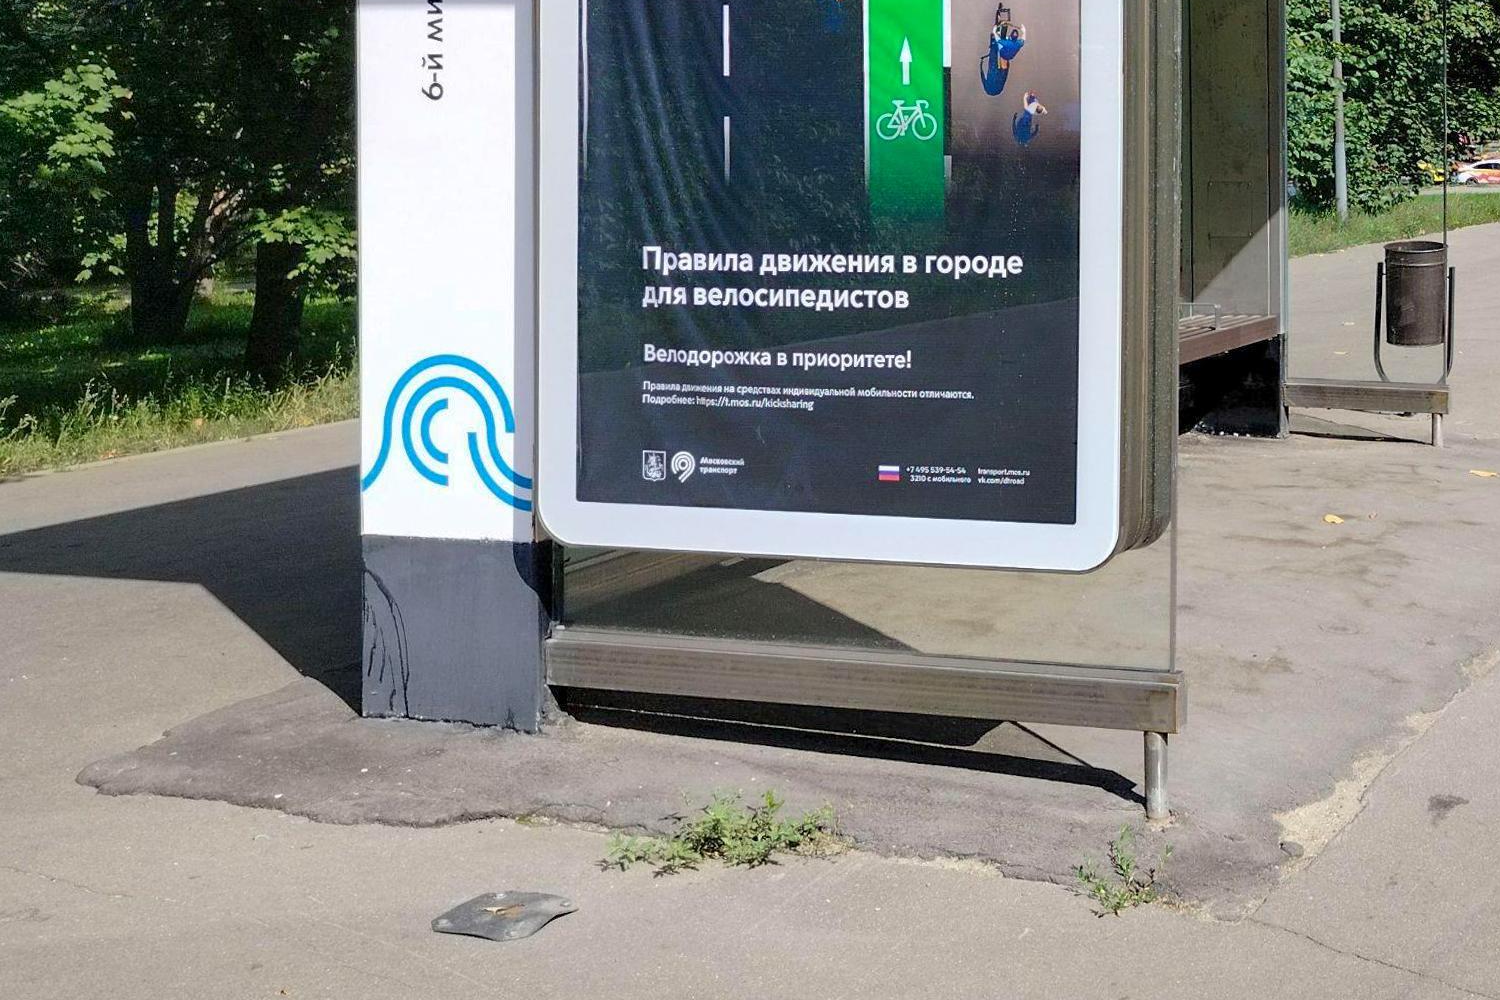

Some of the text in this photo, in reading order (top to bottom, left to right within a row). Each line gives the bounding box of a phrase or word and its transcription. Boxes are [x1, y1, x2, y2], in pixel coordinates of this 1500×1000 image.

[421, 53, 444, 101] 6-й
[642, 245, 1024, 279] Правила движения в городе
[642, 286, 910, 311] для велосипедистов
[643, 343, 912, 371] Велодорожка в приоритете!
[643, 380, 975, 400] Правила движения на средствах индивидуальной мобильности отличаются.
[642, 394, 815, 411] Подробнее: https://t.mos.ru/kicksharing
[699, 456, 745, 466] Московский
[699, 467, 738, 475] транспорт
[932, 475, 972, 484] мобильного
